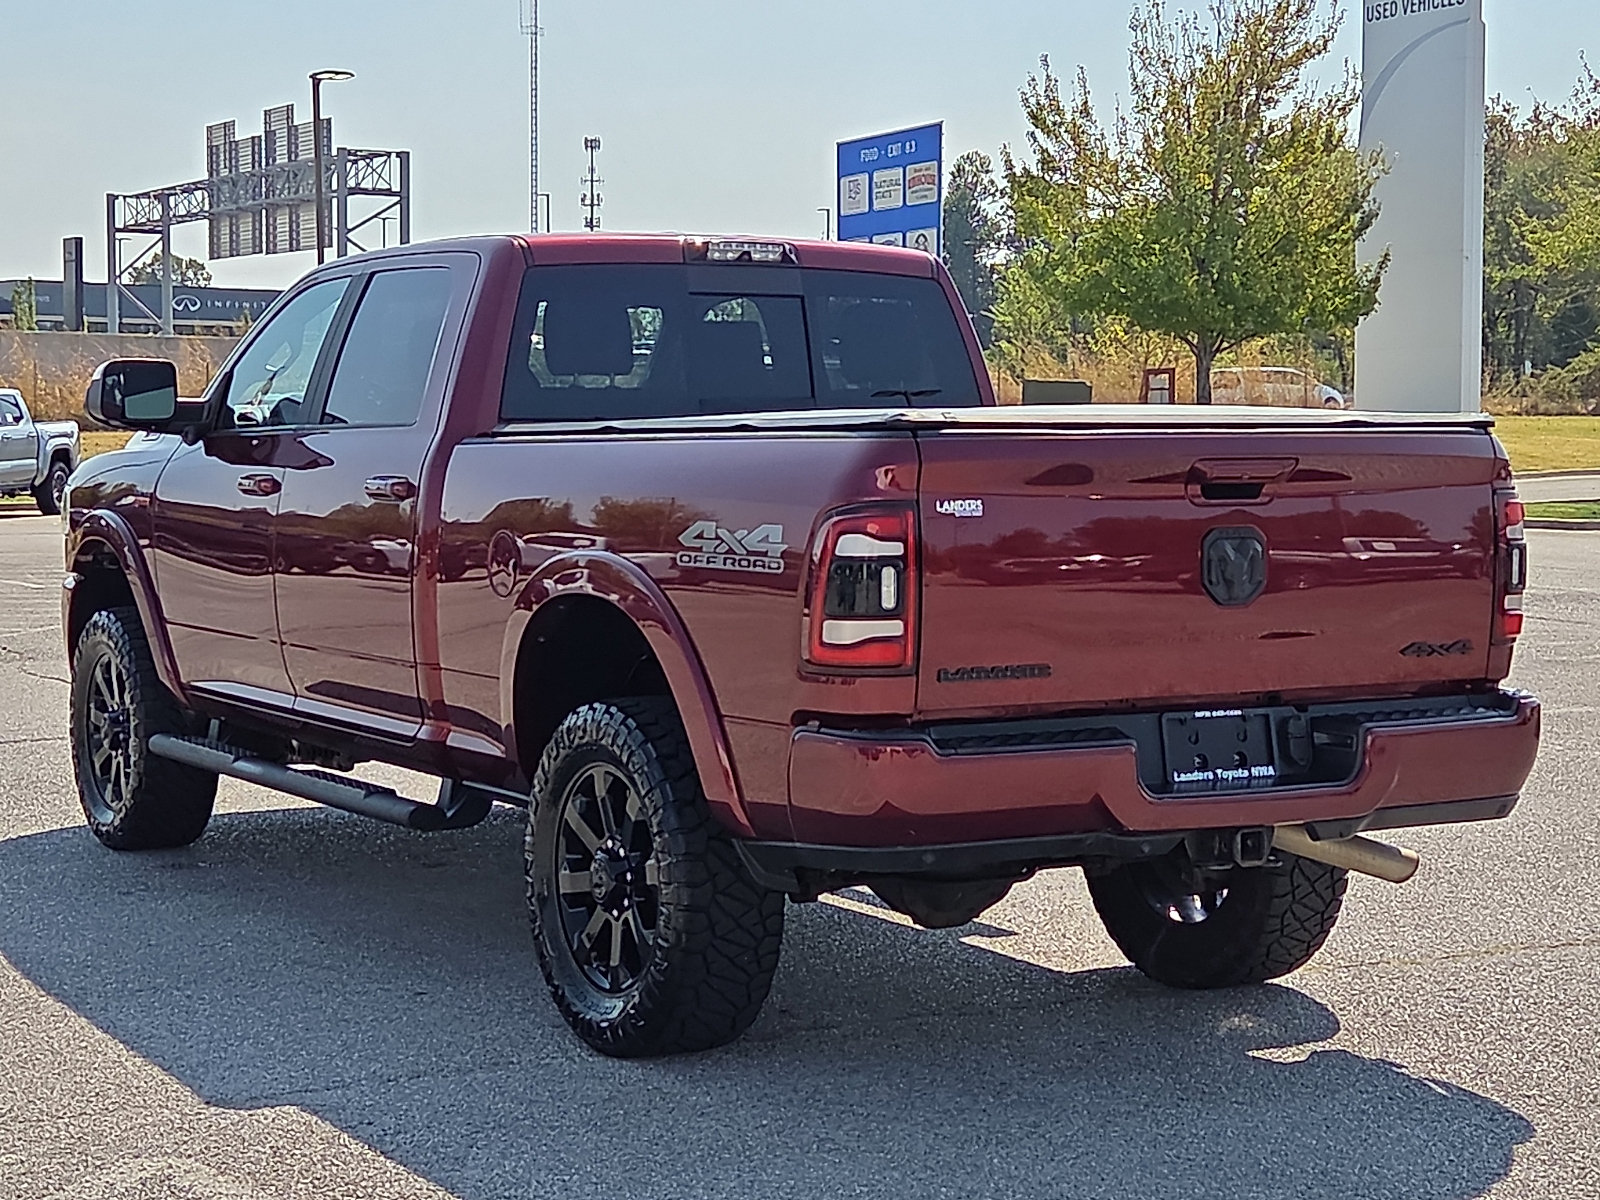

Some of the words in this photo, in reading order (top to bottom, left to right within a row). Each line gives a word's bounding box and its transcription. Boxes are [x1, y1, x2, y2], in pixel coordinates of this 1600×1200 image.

[1366, 0, 1398, 22] USED
[860, 147, 879, 162] FOOD
[887, 142, 902, 158] EXIT
[206, 300, 267, 309] INFINIT
[936, 499, 983, 511] LANDERS
[679, 554, 718, 565] OFF
[722, 556, 782, 571] ROAD
[1215, 768, 1250, 783] Toyota
